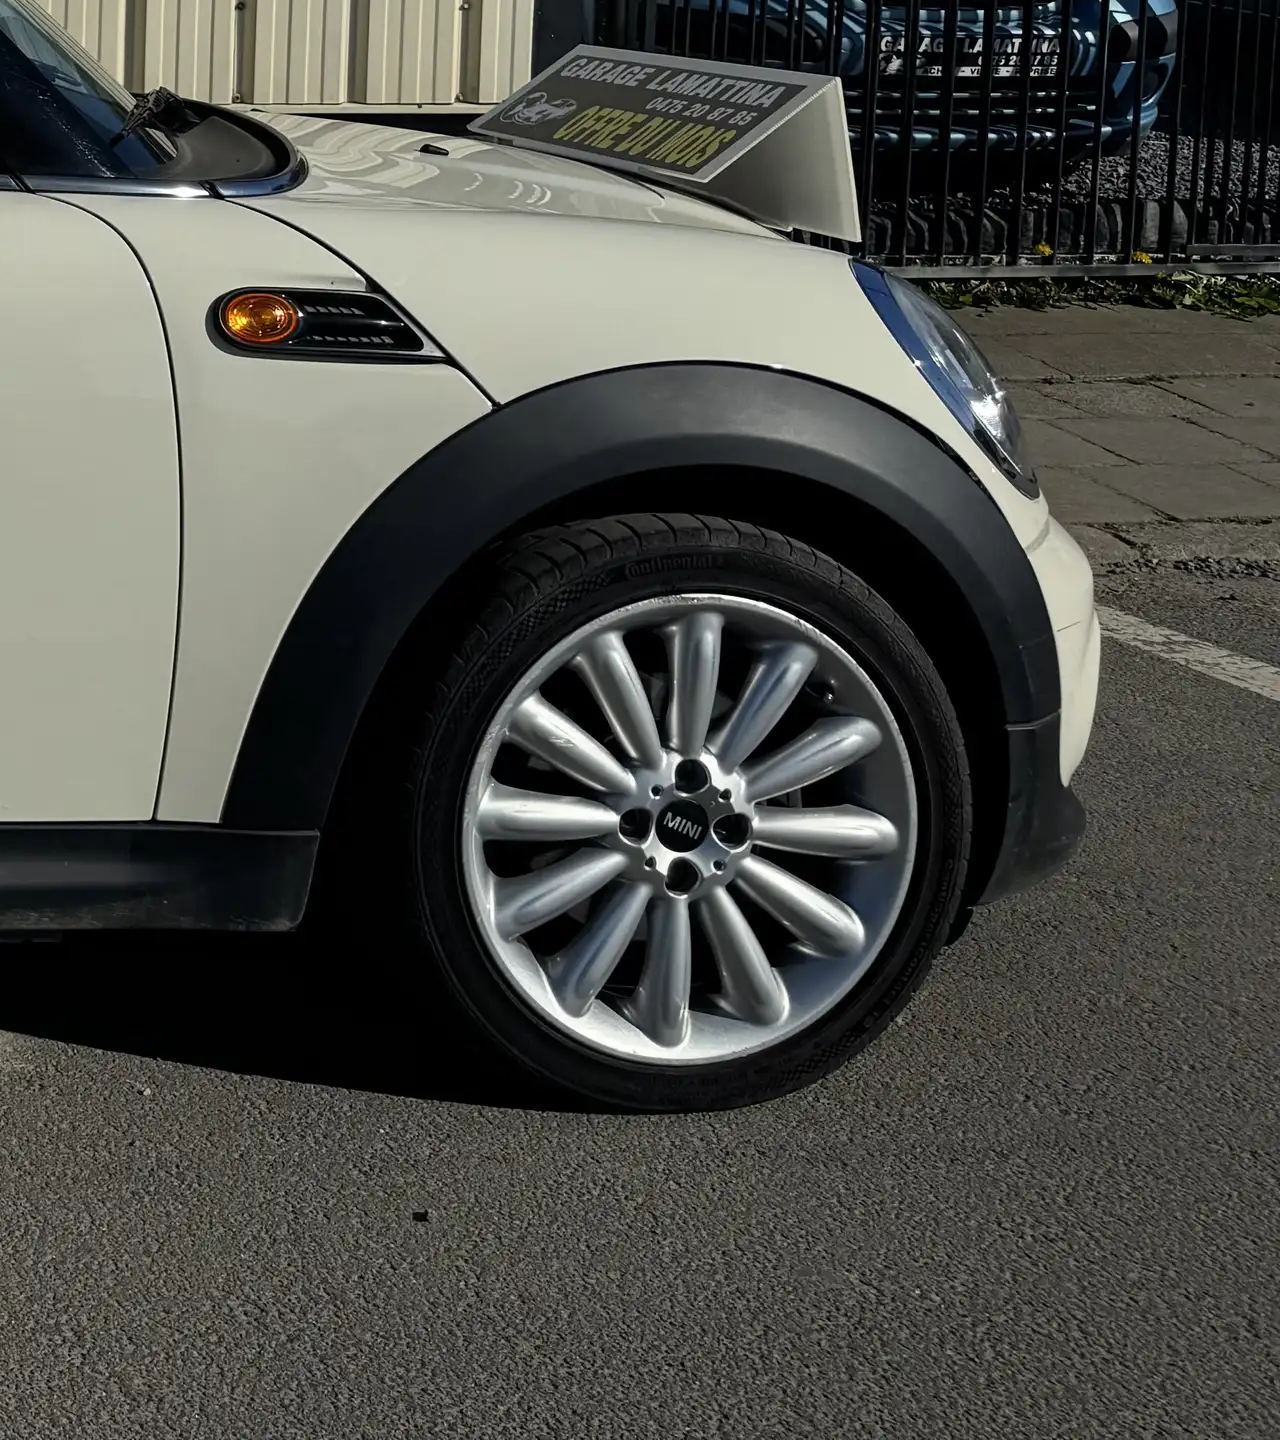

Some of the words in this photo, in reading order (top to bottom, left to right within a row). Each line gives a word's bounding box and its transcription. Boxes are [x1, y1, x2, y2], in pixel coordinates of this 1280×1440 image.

[880, 37, 953, 53] GAAG
[560, 58, 657, 87] GARAGE
[646, 70, 787, 108] LAMATTINA
[552, 105, 649, 149] OFFRE
[645, 96, 684, 114] 0475
[686, 102, 707, 118] 20
[706, 108, 736, 122] 87
[728, 111, 758, 126] 85
[613, 116, 682, 155] DU
[645, 122, 737, 168] MOIS
[663, 811, 703, 840] MINI
